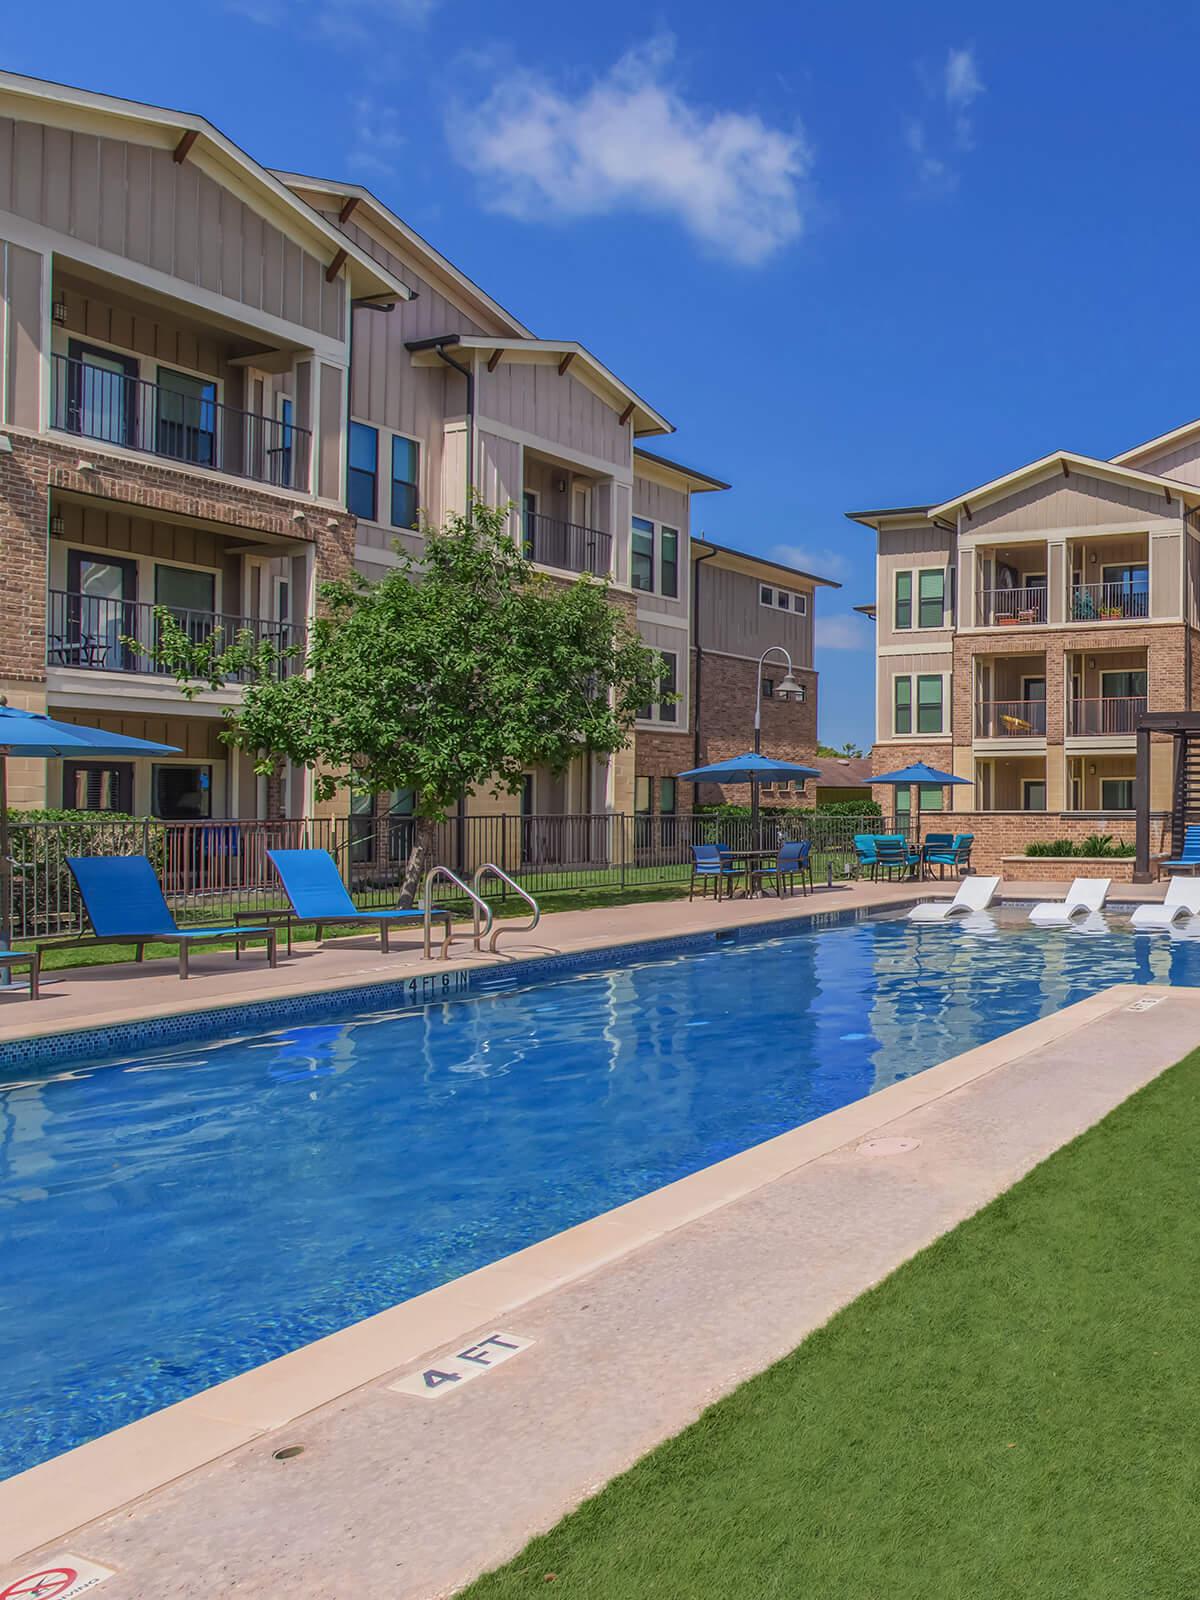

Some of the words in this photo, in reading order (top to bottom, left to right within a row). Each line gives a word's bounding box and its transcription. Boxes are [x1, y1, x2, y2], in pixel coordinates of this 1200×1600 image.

[409, 978, 417, 992] 4
[423, 976, 436, 989] FT
[442, 973, 450, 986] 6
[456, 970, 468, 984] IN
[422, 1369, 462, 1388] 4
[456, 1334, 519, 1365] FT
